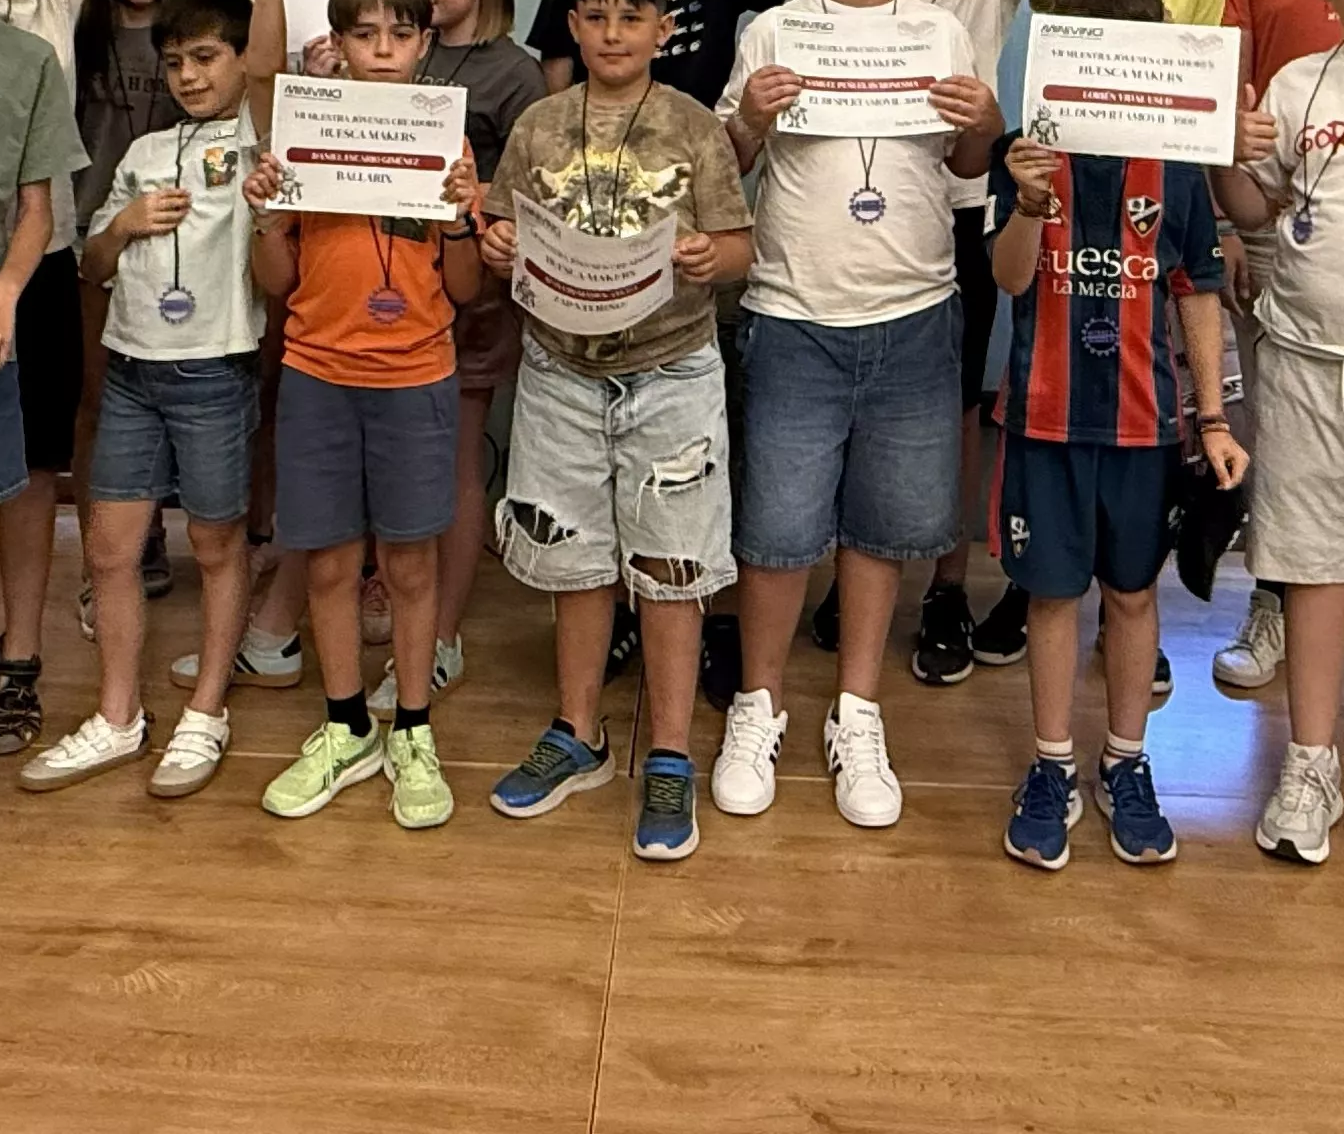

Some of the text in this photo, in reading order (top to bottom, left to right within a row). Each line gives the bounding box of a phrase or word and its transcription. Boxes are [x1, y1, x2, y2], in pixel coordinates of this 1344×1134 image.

[1079, 66, 1183, 83] HUESCA MAKERS
[321, 128, 416, 141] HUESCA MAKERS
